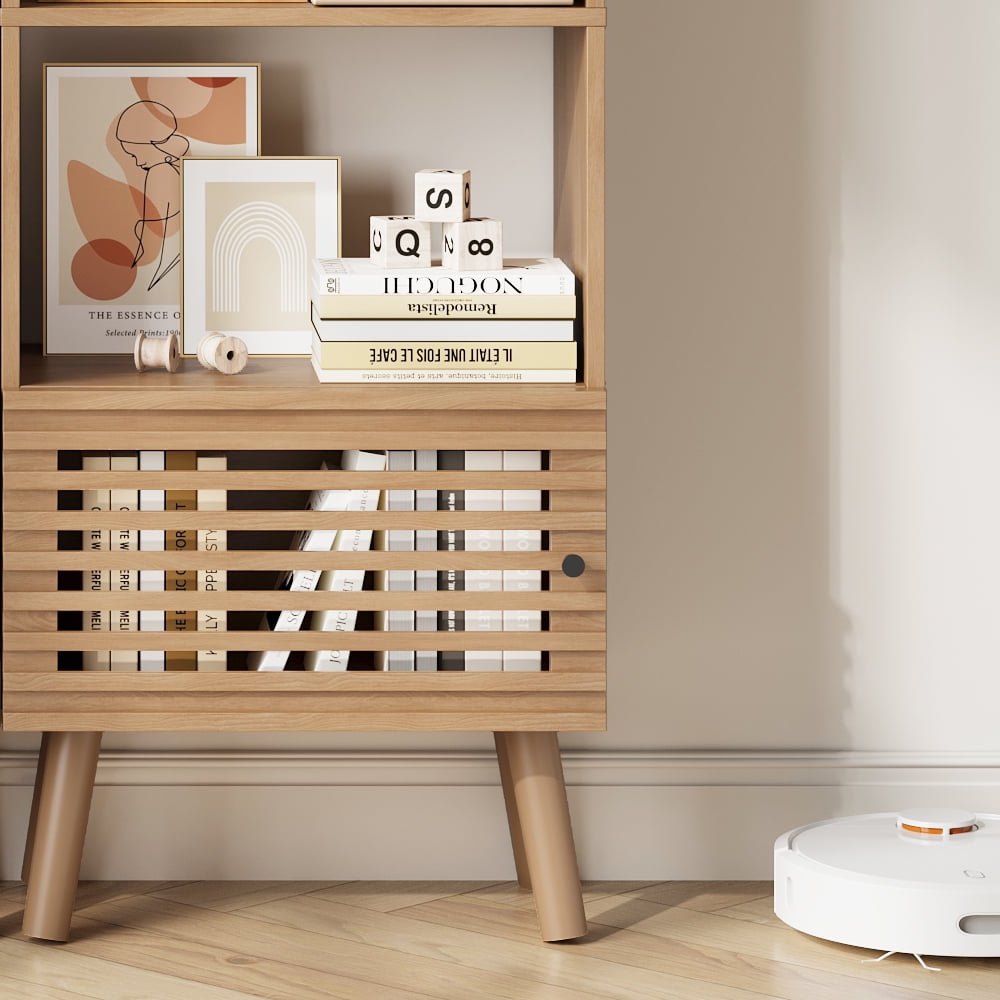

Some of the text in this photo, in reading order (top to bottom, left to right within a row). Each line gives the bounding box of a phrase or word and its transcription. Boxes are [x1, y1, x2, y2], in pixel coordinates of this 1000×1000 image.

[426, 188, 453, 209] S
[395, 229, 420, 258] Q
[468, 238, 494, 256] 8
[384, 277, 523, 294] NOGUCHI
[89, 312, 181, 320] THE ESSENCE O
[408, 303, 497, 315] Remodelista
[106, 329, 137, 338] Selected
[370, 349, 513, 365] IL ÉTAIT UNE FOIS LE CAFÉ
